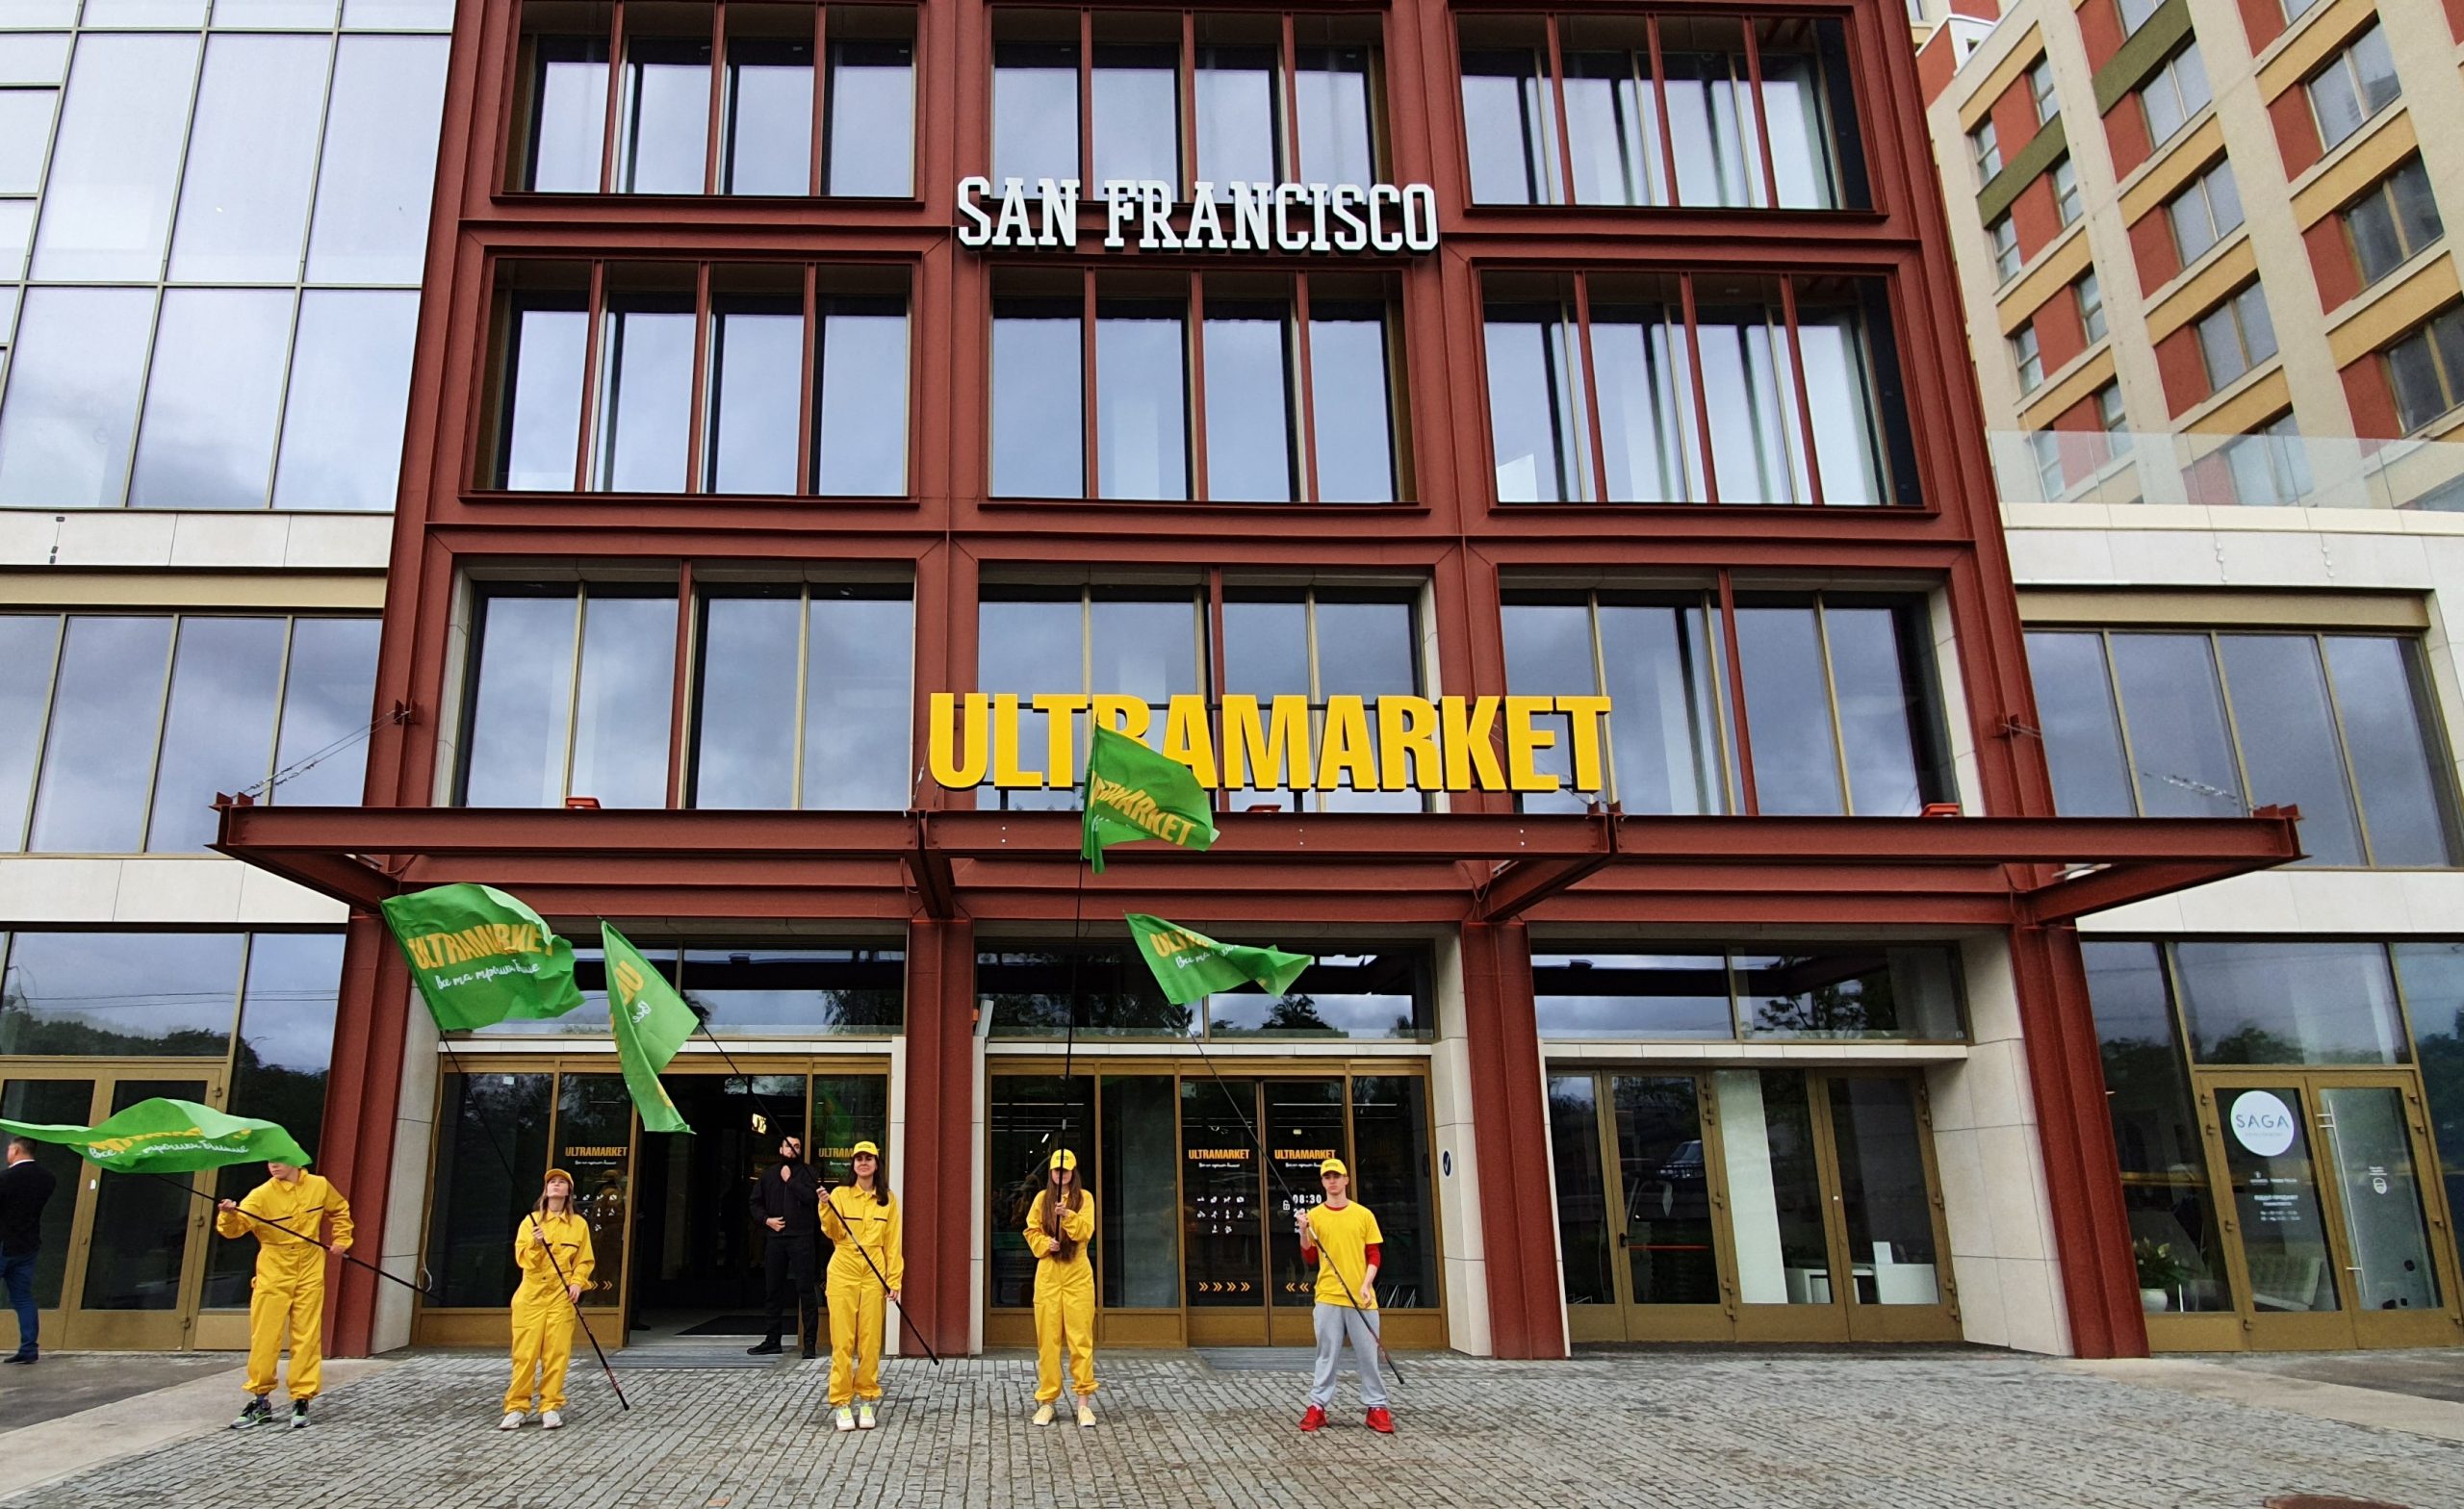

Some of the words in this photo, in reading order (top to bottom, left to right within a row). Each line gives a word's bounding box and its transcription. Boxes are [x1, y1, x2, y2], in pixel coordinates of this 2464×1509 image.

[957, 176, 1080, 247] SAN
[1103, 179, 1440, 252] FRANCISCO
[930, 692, 1611, 793] ULTRAMARKET
[2235, 1114, 2290, 1129] SAGA
[565, 1146, 628, 1157] ULTRAMARKET
[818, 1147, 855, 1157] ULTRAM
[1188, 1149, 1250, 1160] ULTRAMARKET
[1273, 1149, 1336, 1160] ULTRAMARKET
[1292, 1193, 1322, 1204] 08:30
